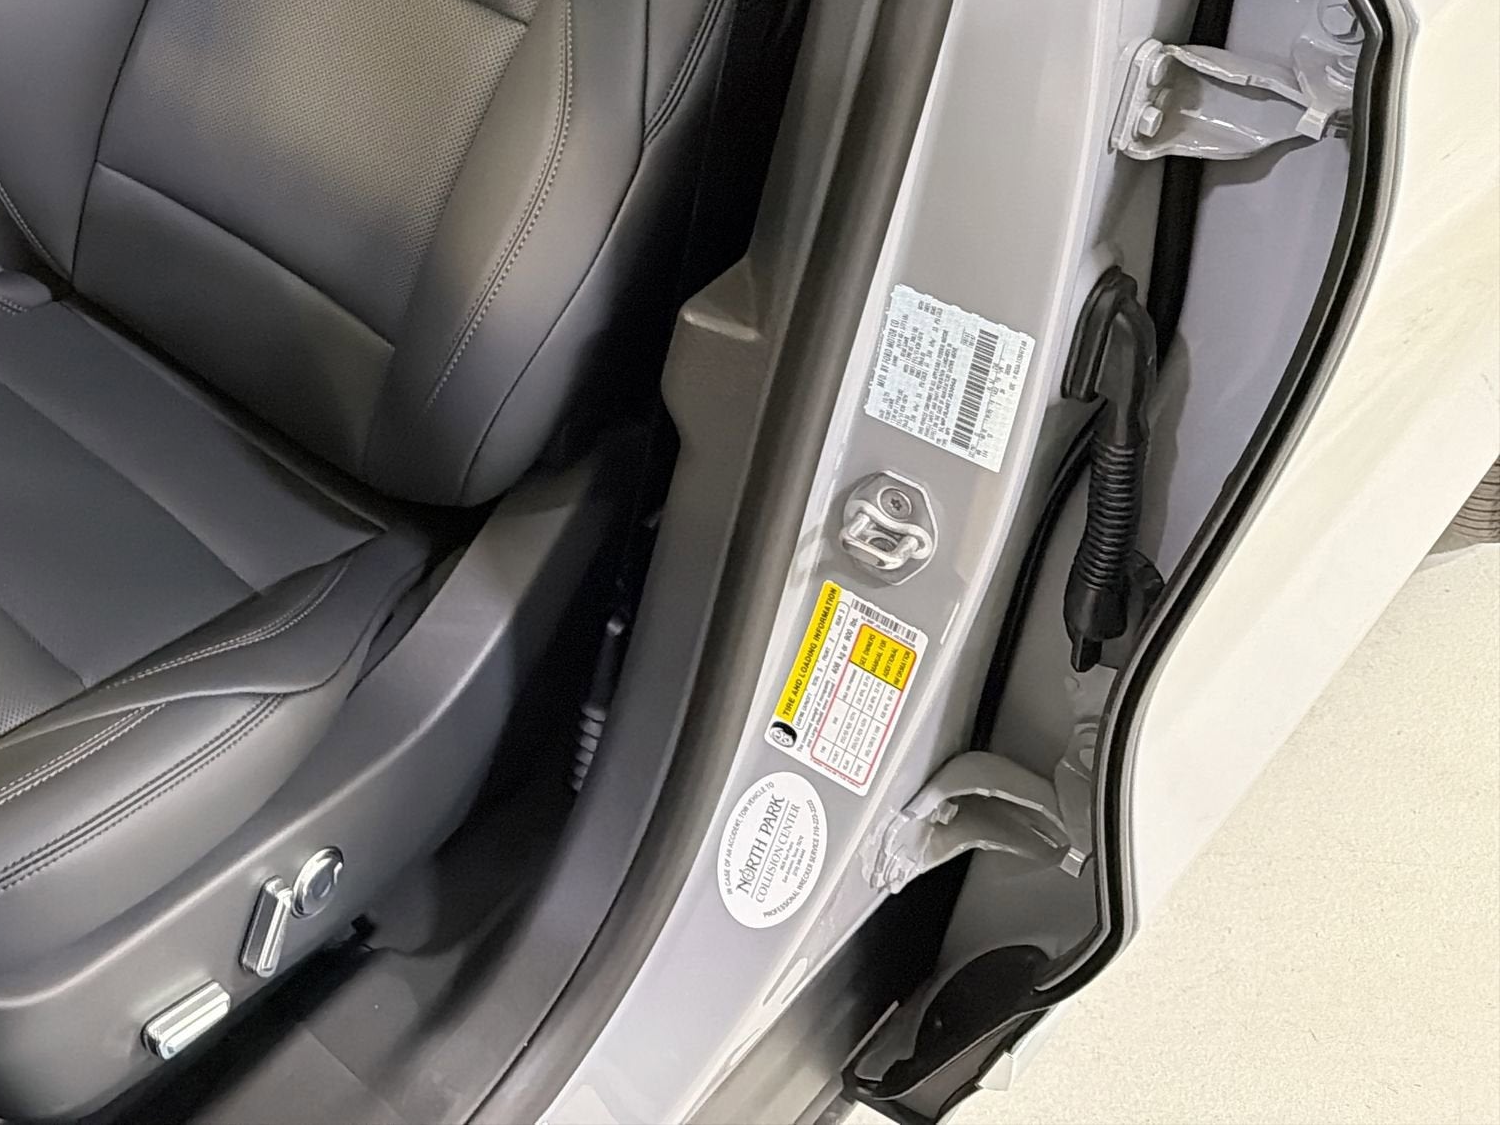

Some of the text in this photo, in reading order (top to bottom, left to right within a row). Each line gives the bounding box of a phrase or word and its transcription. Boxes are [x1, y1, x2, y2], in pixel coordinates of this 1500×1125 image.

[885, 327, 897, 348] MOTOR
[881, 347, 893, 364] FORD
[782, 586, 837, 717] TIRE AND LOADING INFORMATION
[763, 780, 775, 790] TO
[745, 786, 766, 806] VEHICLE
[737, 805, 749, 818] TOW
[725, 848, 732, 857] AN
[734, 792, 785, 895] NORTH PARK
[754, 802, 801, 903] COLLISION CENTER
[724, 858, 730, 867] OF
[762, 889, 800, 917] PROFESSIONAL
[796, 863, 813, 890] WRECKER
[809, 837, 819, 862] SERVICE
